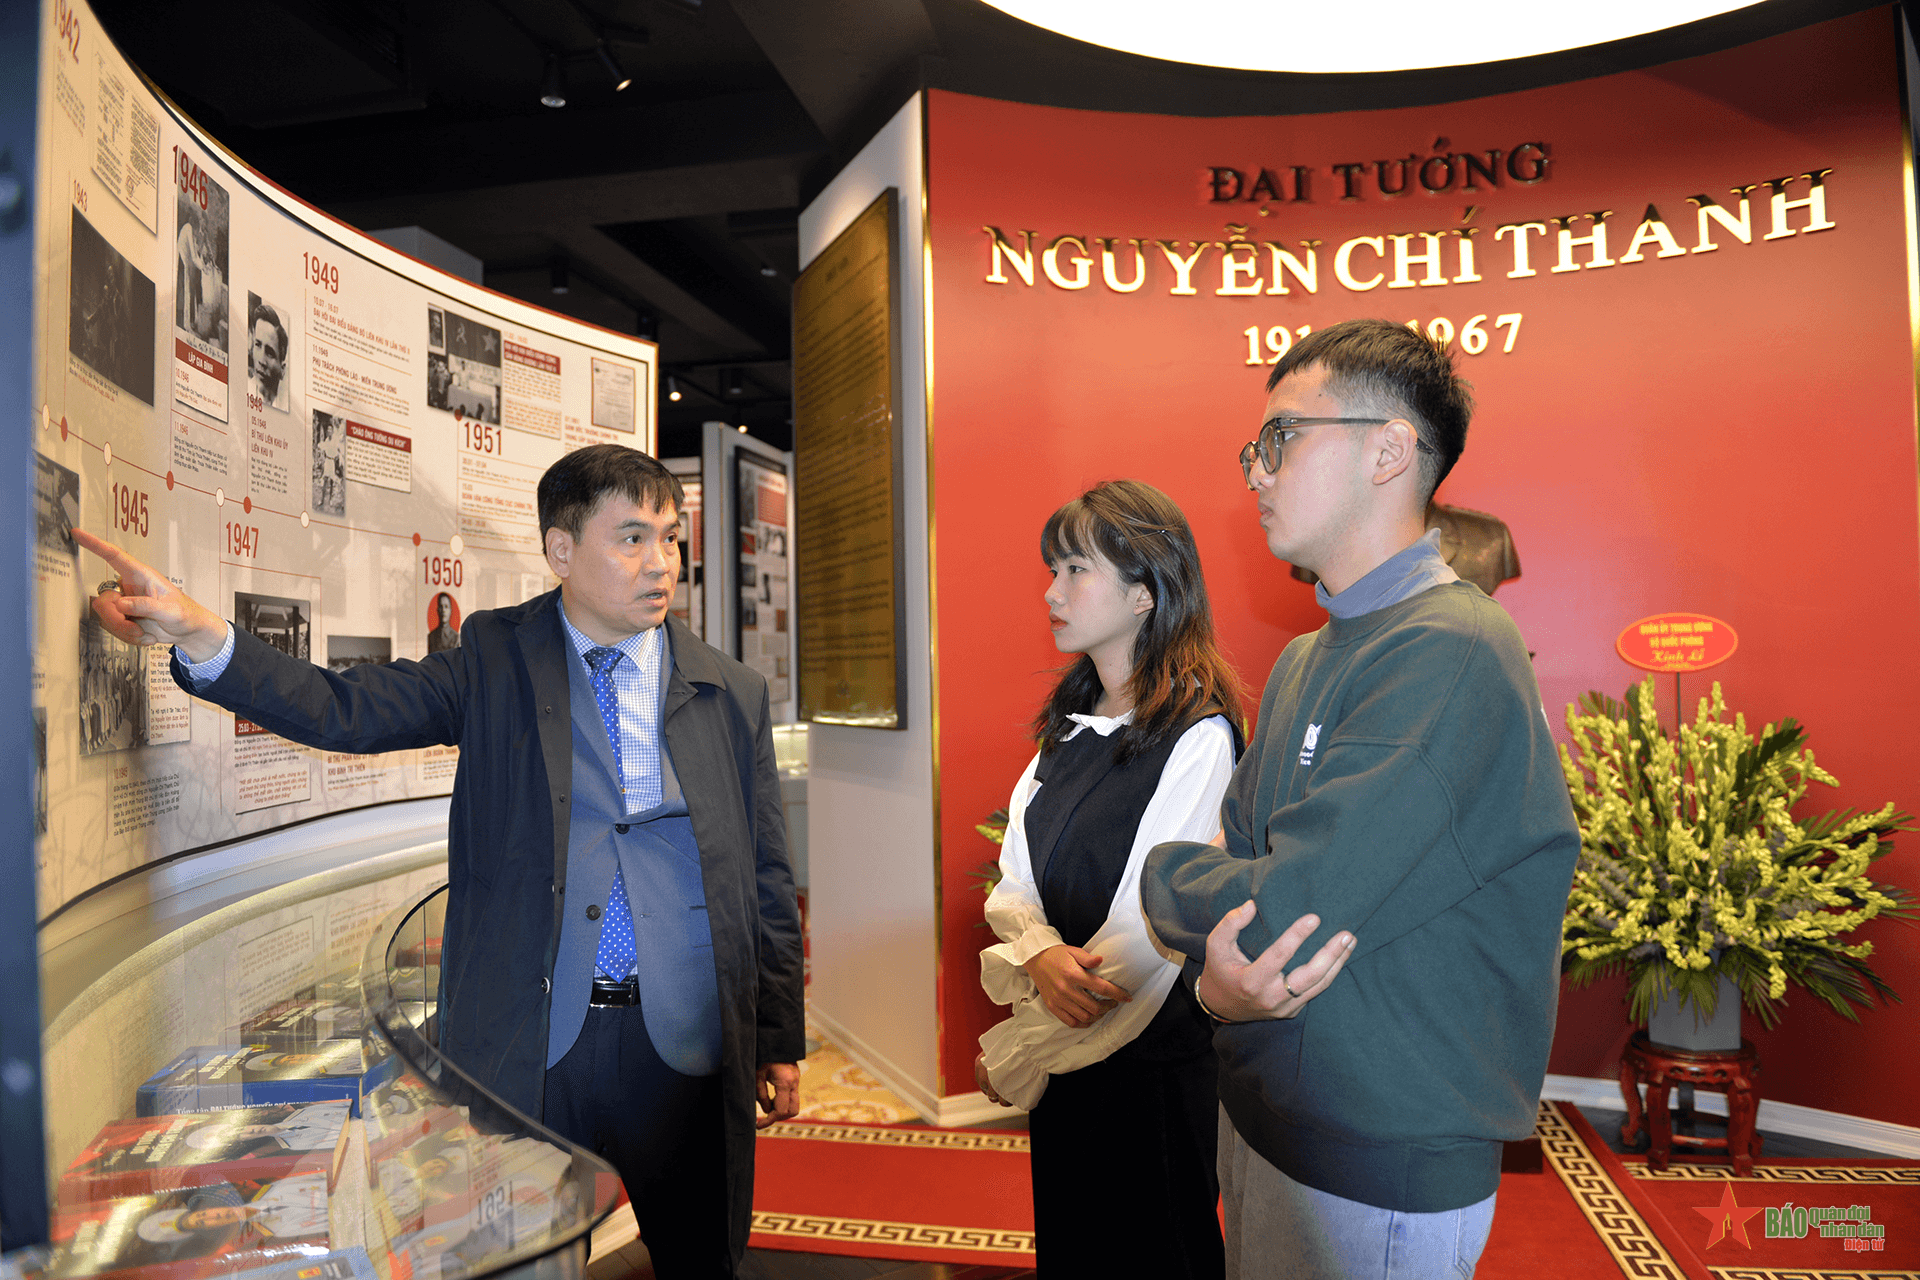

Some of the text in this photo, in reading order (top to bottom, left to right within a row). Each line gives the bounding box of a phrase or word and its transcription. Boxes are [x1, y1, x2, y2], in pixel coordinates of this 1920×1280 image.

[173, 144, 208, 211] 1946
[1207, 136, 1550, 217] ĐẠI TƯỚNG
[983, 168, 1837, 297] NGUYỄN CHÍ THANH
[303, 251, 339, 294] 1949
[246, 392, 263, 413] 1948
[464, 421, 502, 456] 1951
[112, 482, 149, 538] 1945
[226, 521, 259, 559] 1947
[422, 555, 463, 588] 1950
